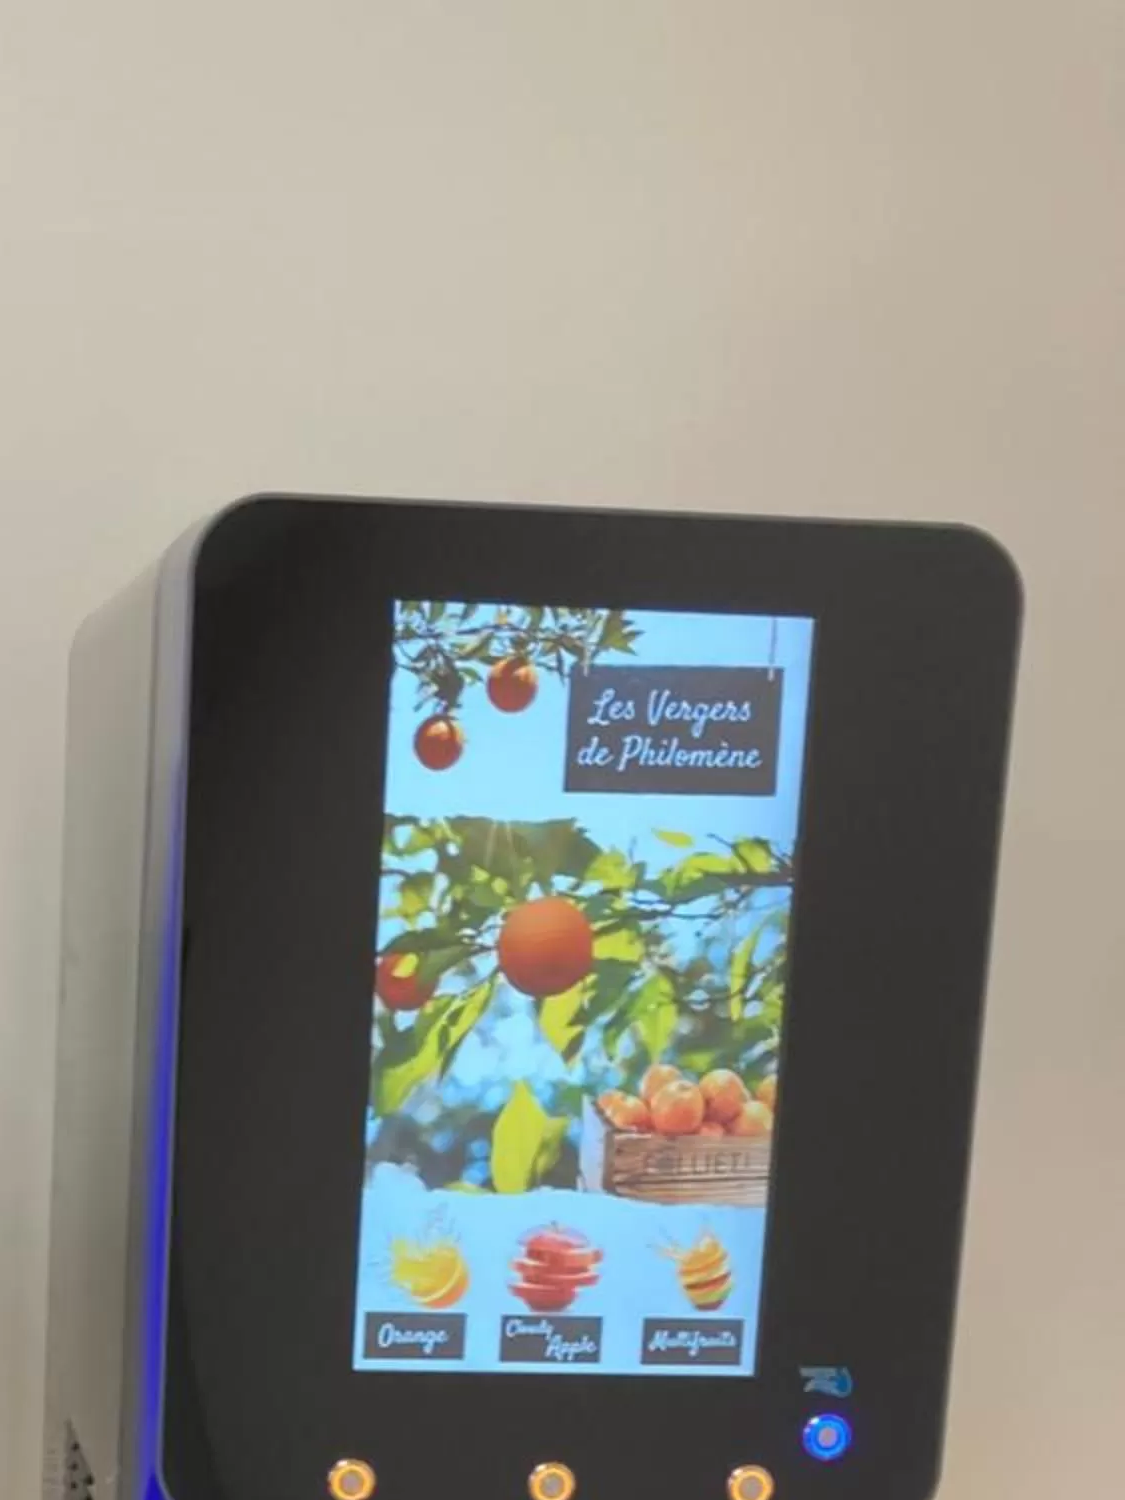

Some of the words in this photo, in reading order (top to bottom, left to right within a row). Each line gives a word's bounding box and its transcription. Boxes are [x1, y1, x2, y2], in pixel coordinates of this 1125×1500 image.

[587, 688, 635, 726] Les
[647, 689, 751, 738] Vergers
[577, 736, 614, 766] de
[616, 734, 763, 772] Philomène
[378, 1322, 448, 1354] Orange
[544, 1334, 597, 1361] Apple
